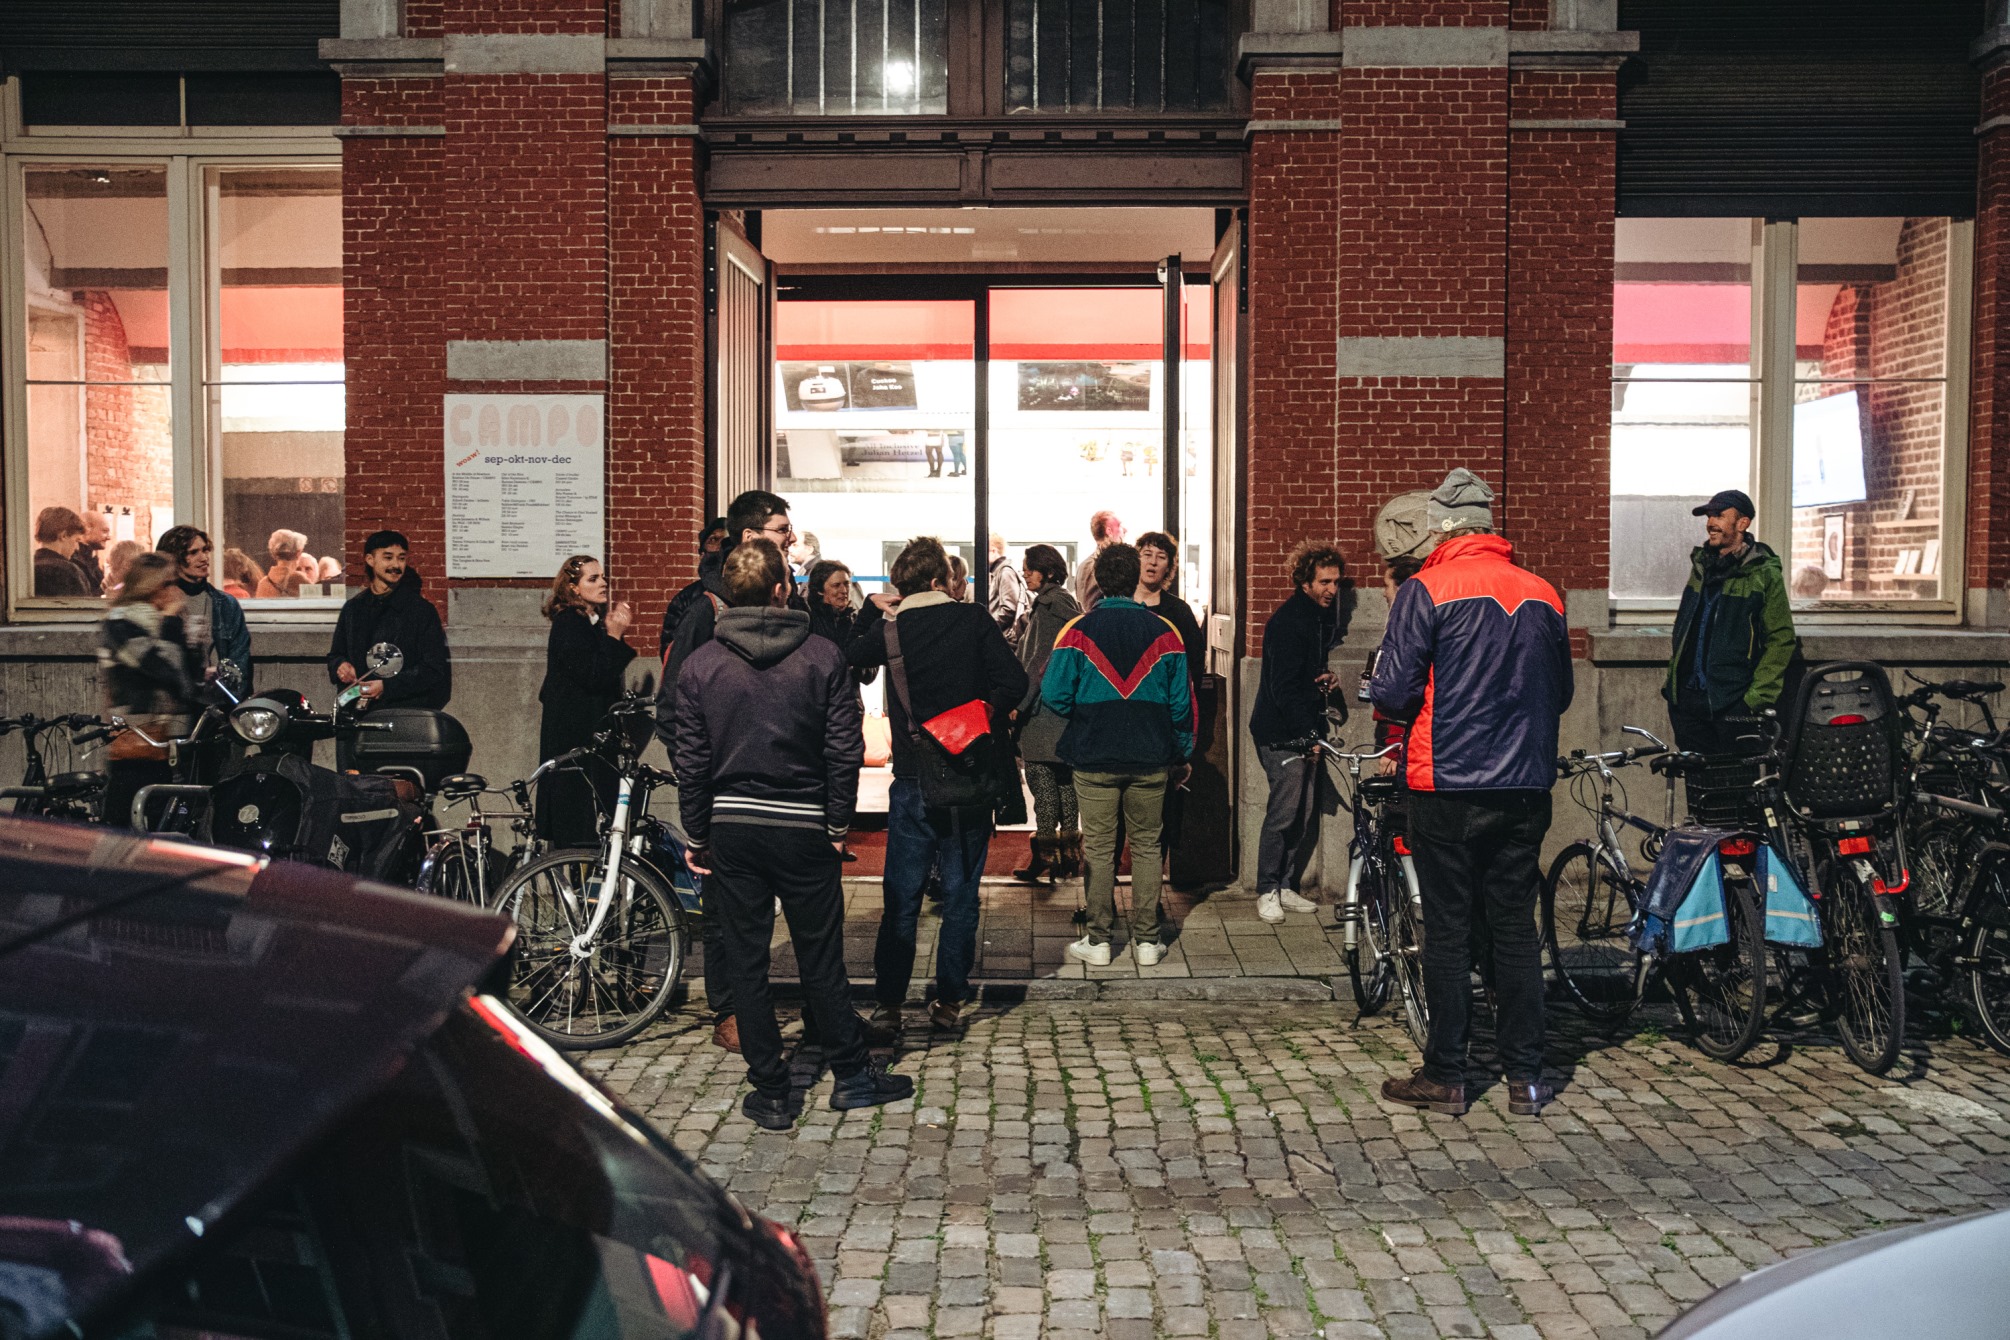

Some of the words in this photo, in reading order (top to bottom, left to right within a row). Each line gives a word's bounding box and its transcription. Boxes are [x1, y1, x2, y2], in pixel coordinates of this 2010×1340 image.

[451, 403, 599, 447] CAMPO
[456, 449, 480, 467] woaw!
[484, 454, 572, 466] sep-okt-nov-dec
